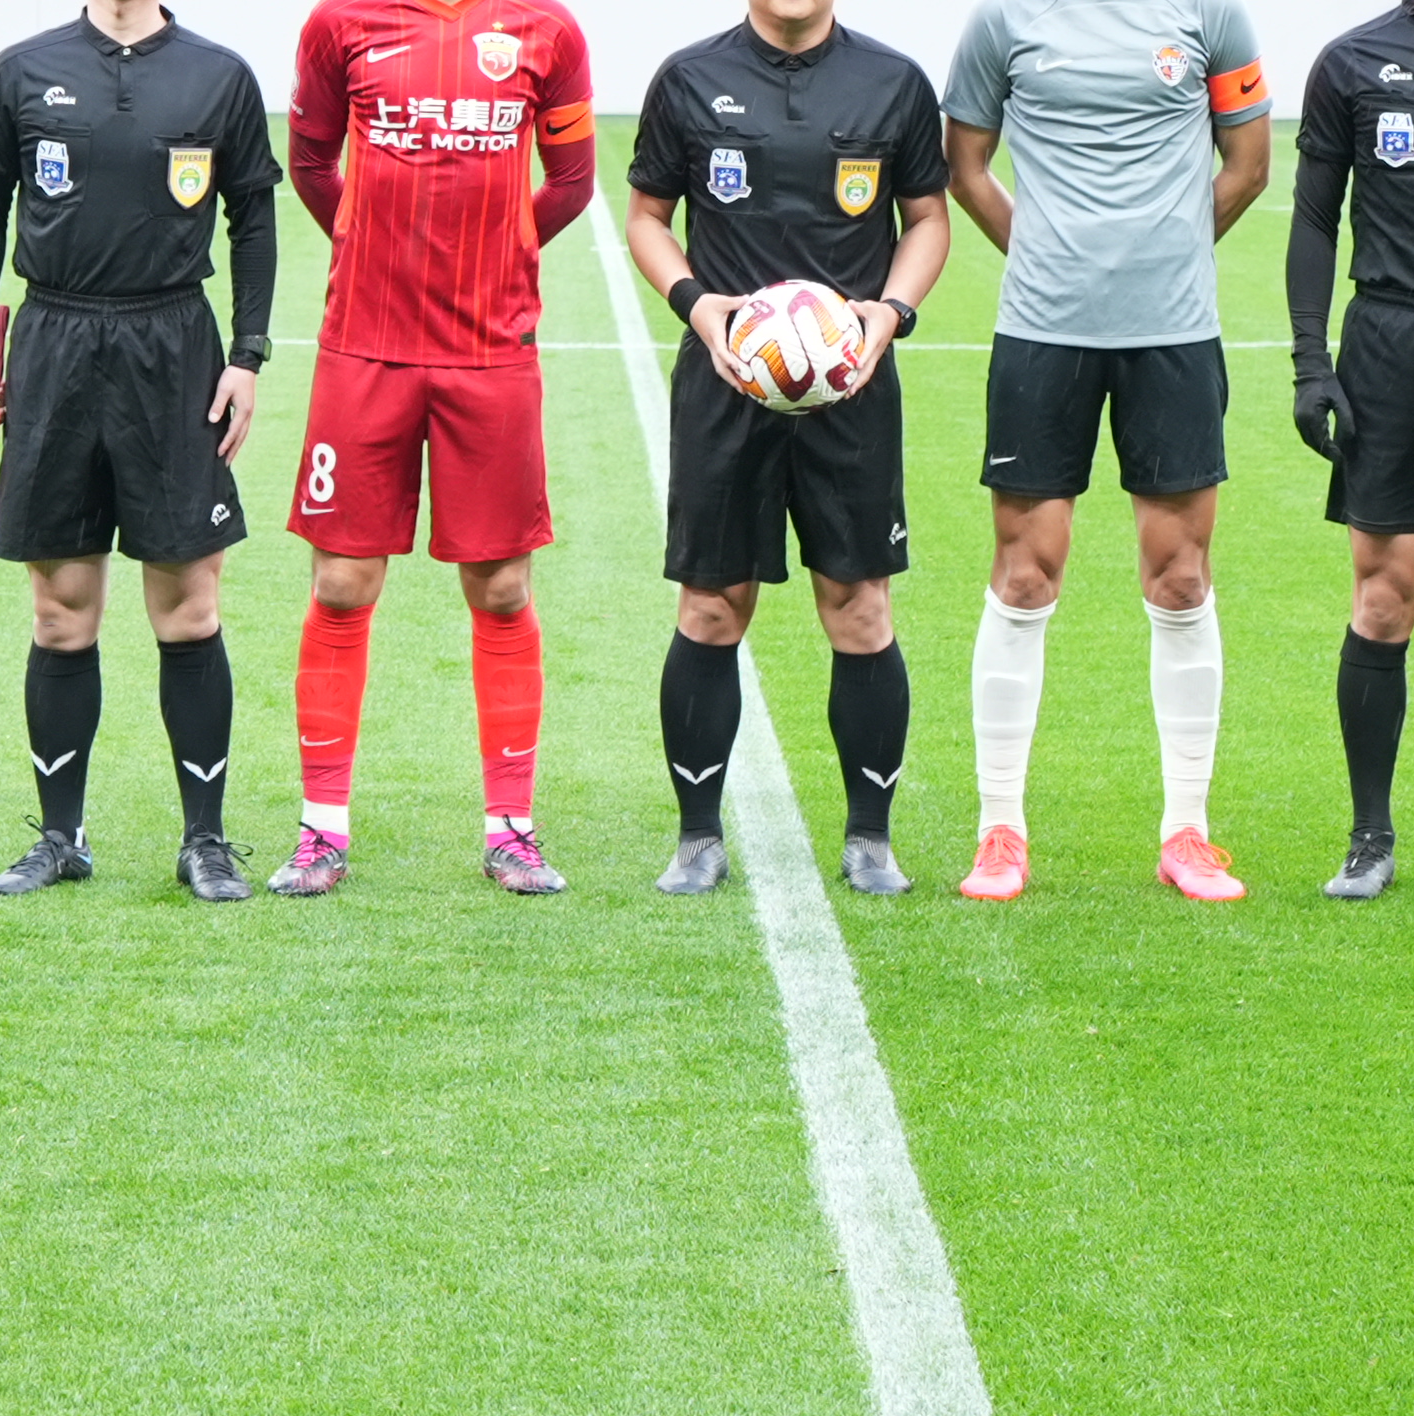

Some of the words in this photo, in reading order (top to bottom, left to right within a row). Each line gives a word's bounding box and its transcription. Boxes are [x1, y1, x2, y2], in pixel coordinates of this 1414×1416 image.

[369, 97, 526, 132] 上汽集团
[1380, 114, 1412, 127] SFA
[368, 129, 423, 150] SAIC
[431, 133, 518, 152] MOTOR
[37, 142, 67, 158] SFA
[713, 150, 745, 164] SFA
[173, 154, 208, 162] REFEREE
[841, 164, 877, 172] REFEREE
[309, 442, 337, 502] 8
